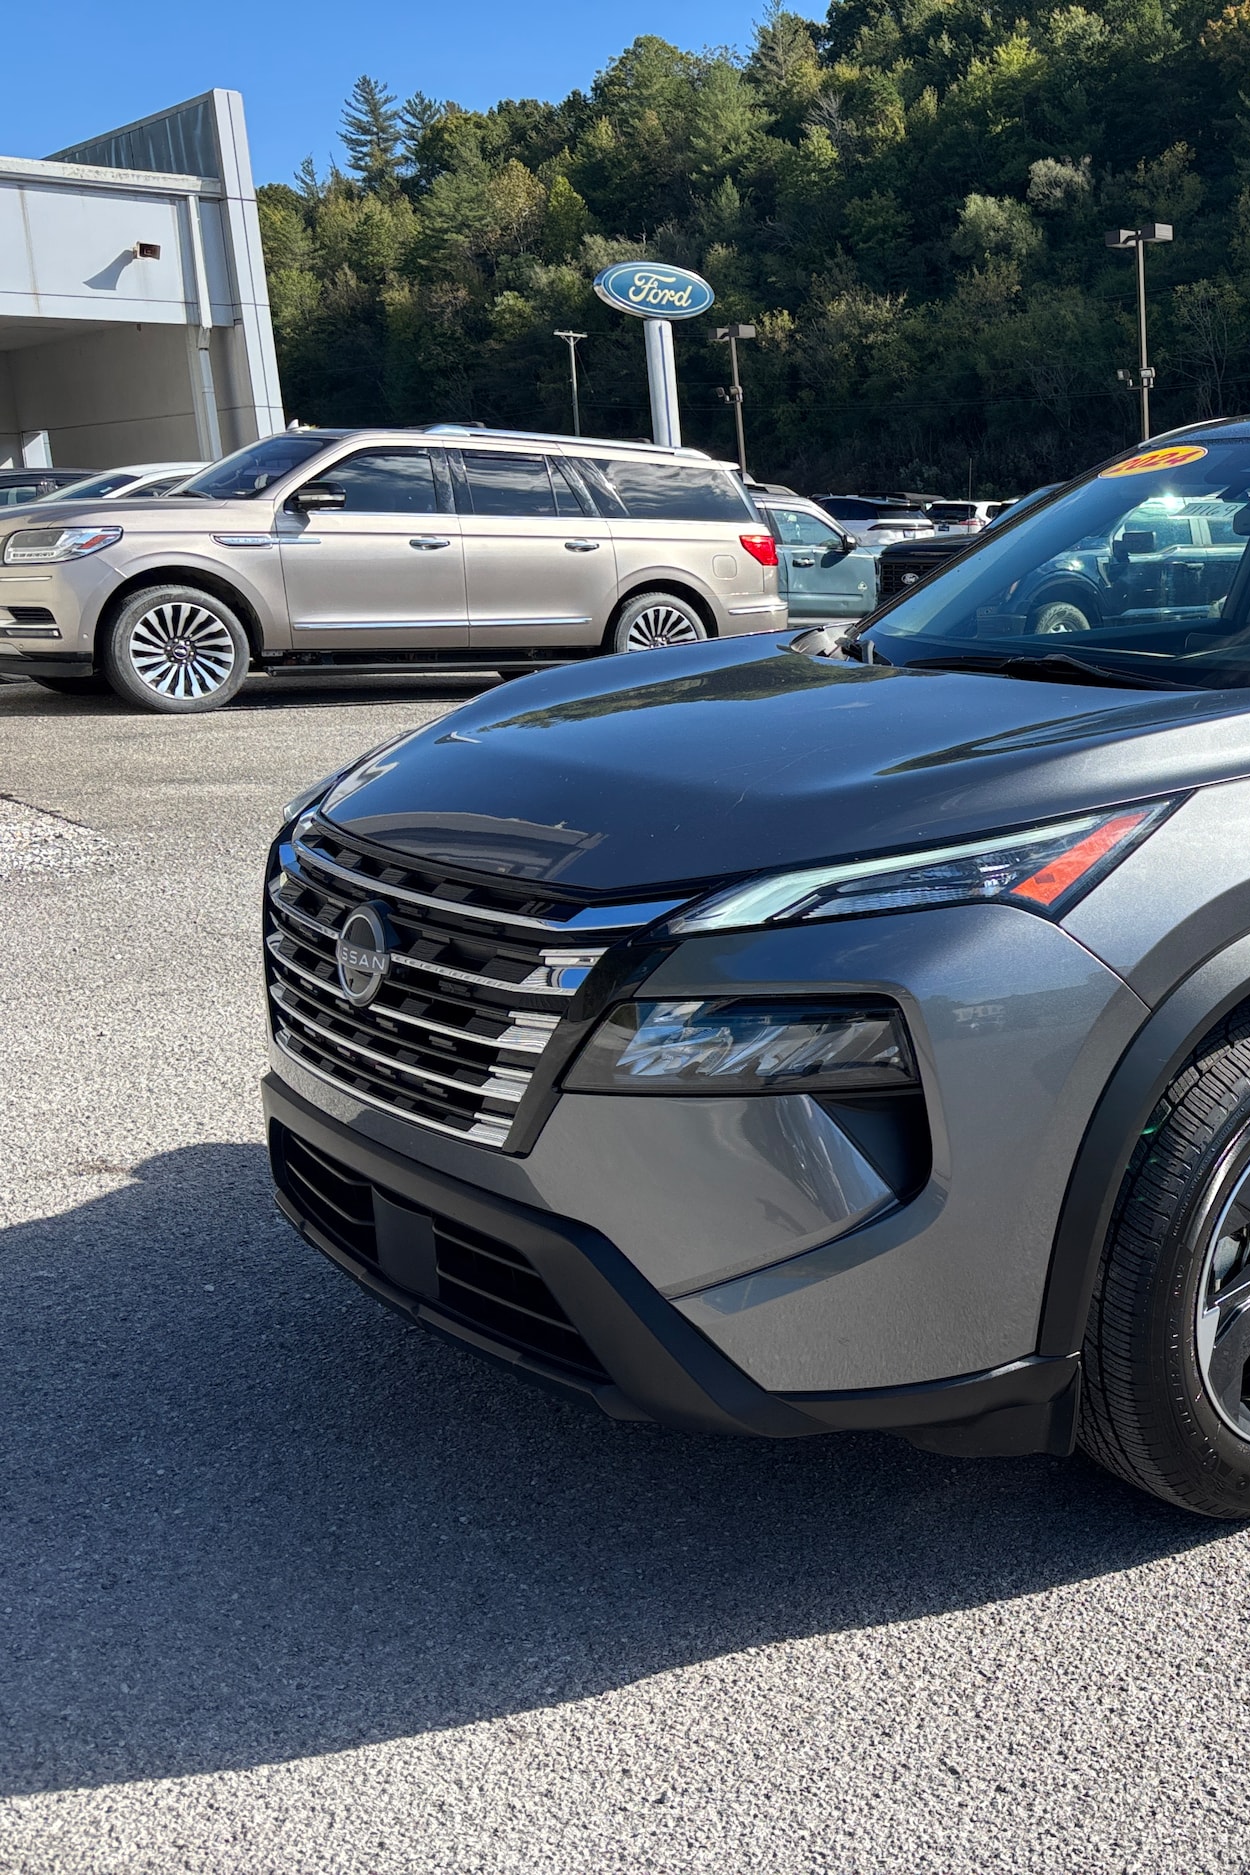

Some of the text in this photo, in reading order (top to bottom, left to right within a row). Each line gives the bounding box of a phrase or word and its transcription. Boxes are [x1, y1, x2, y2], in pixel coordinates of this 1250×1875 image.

[628, 272, 693, 307] Ford
[1107, 450, 1201, 474] 2024
[342, 947, 385, 970] SSAN
